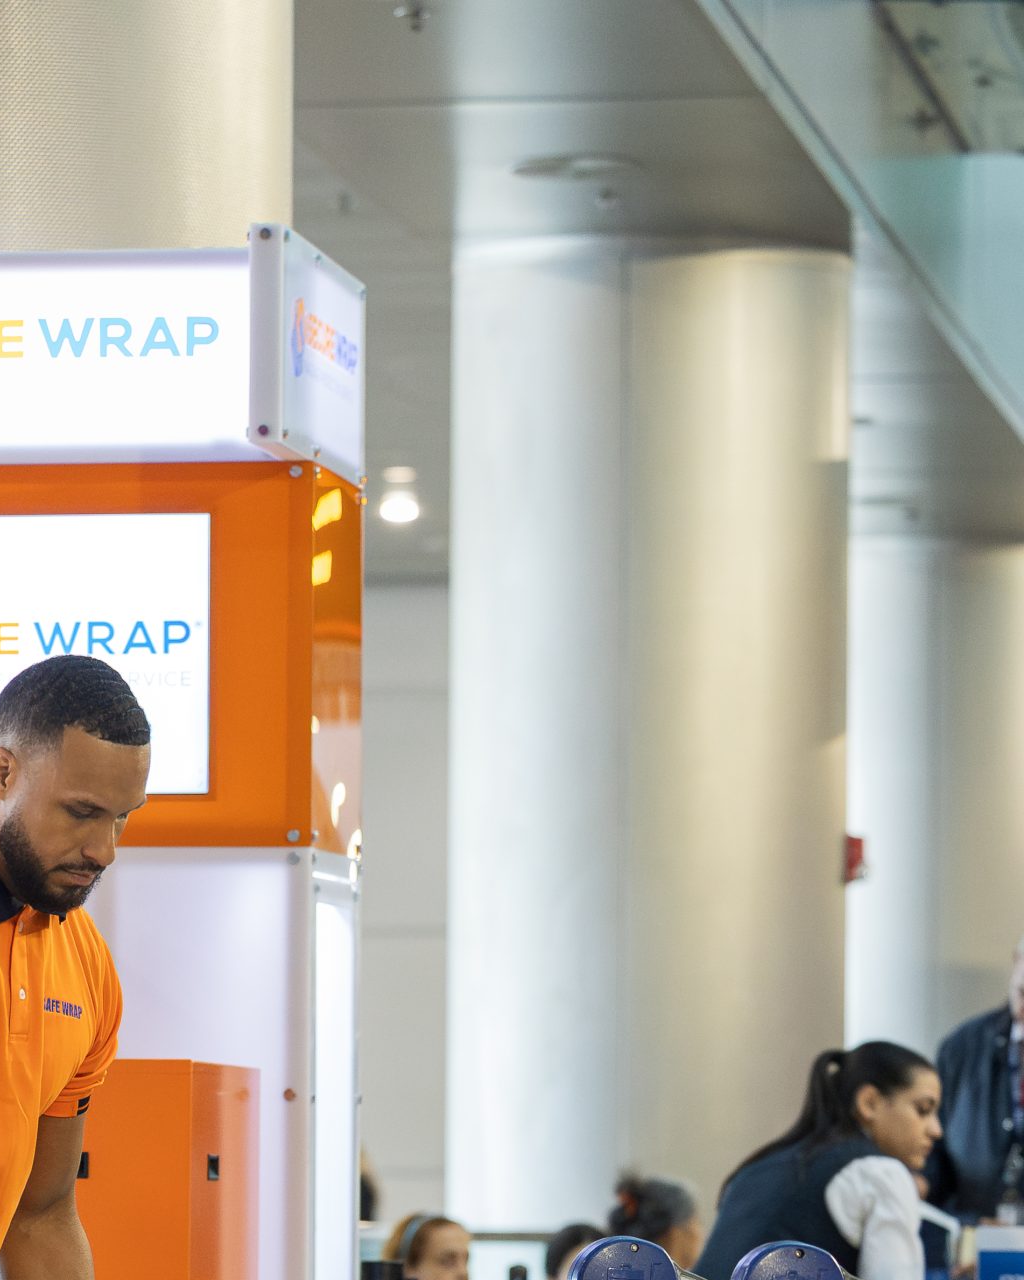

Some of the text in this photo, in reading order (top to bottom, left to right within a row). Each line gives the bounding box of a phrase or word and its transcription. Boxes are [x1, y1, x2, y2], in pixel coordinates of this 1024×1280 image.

[37, 316, 220, 359] WRAP
[33, 619, 192, 655] WRAP
[129, 670, 193, 688] RVICE
[61, 1001, 83, 1020] WRAP
